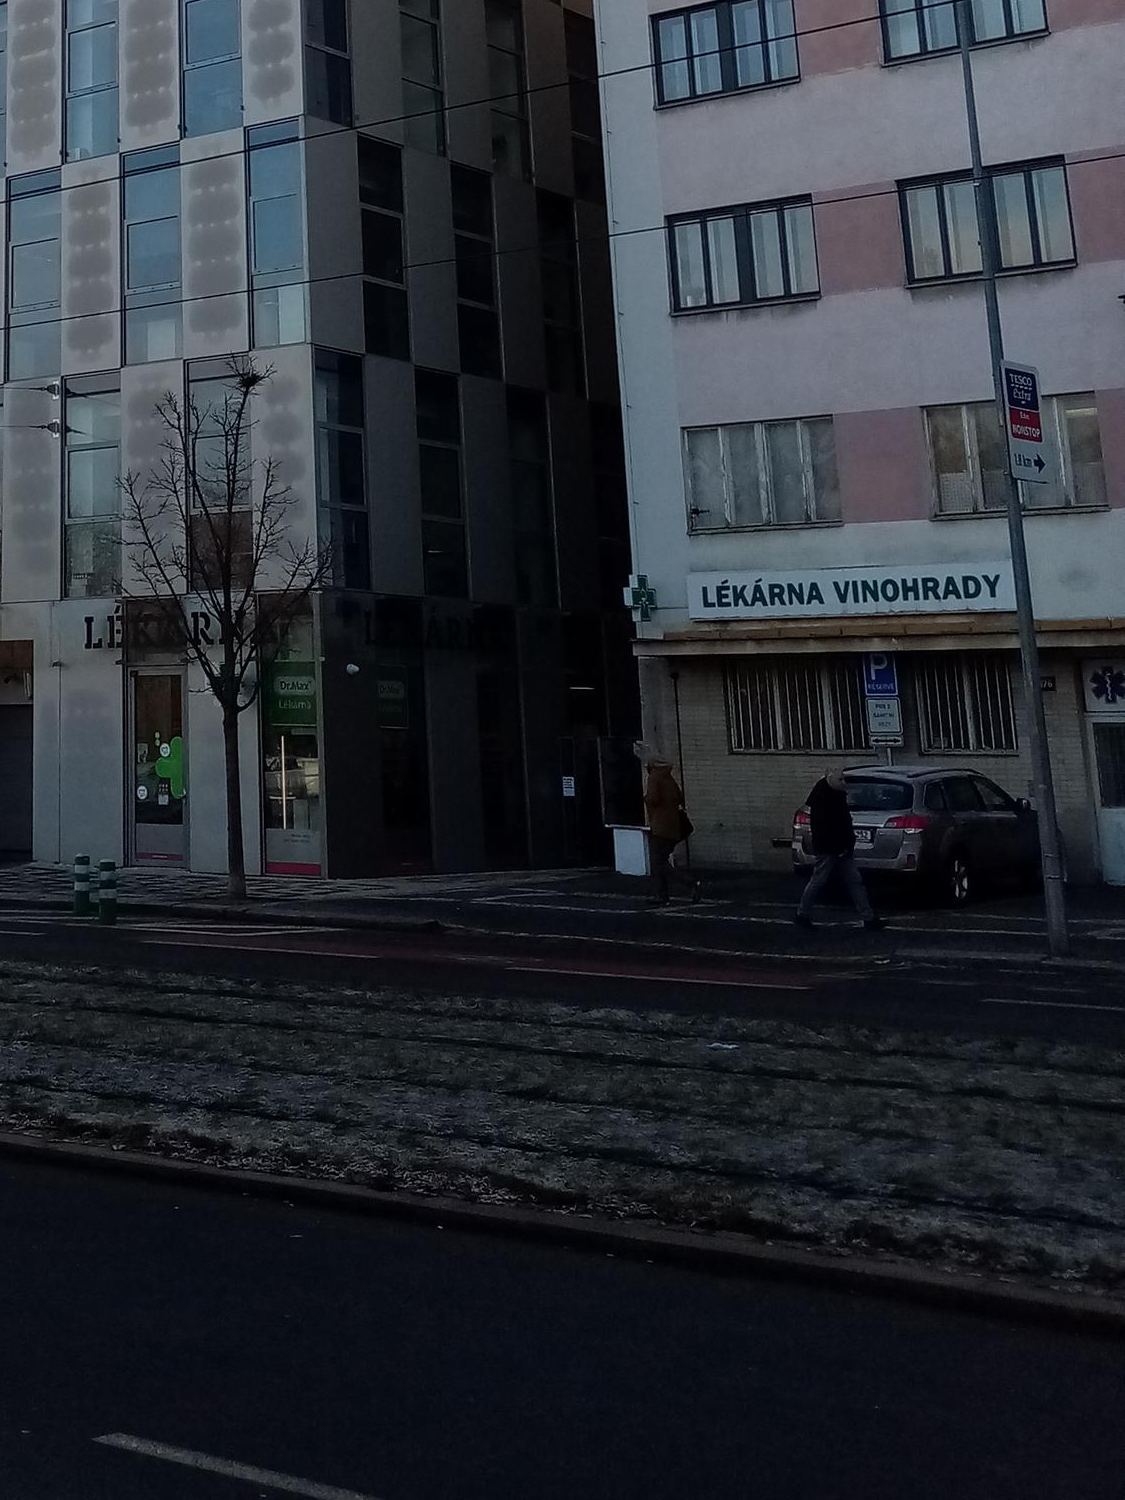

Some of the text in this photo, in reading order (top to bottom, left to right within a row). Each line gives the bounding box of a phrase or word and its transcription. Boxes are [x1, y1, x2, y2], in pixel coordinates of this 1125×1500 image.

[1009, 373, 1033, 387] TESCO
[1012, 423, 1041, 439] NONSTOP
[702, 573, 1001, 608] LÉKÁRNA VINOHRADY
